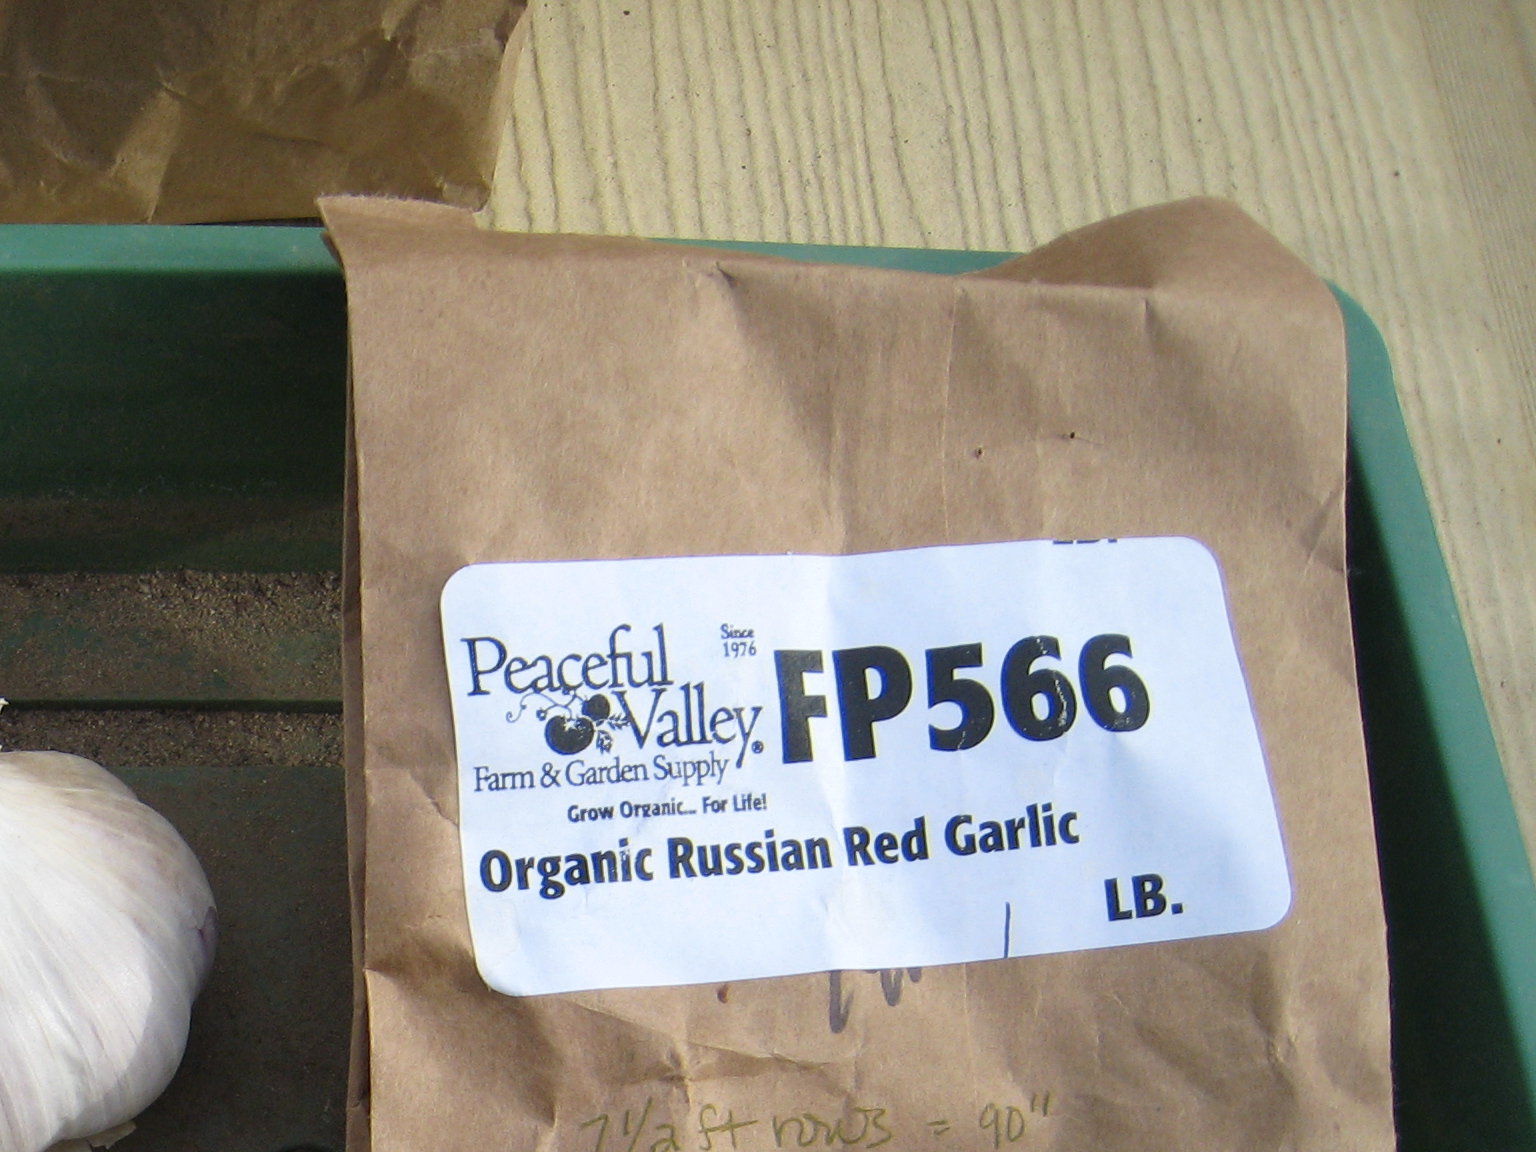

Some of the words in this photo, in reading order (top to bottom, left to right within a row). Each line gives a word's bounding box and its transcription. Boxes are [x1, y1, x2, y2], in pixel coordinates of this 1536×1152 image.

[720, 623, 755, 639] Since
[723, 640, 757, 658] 1976
[460, 622, 675, 696] Peaceful
[773, 633, 1151, 764] FP566
[474, 766, 535, 792] Farm
[540, 762, 561, 788] &
[565, 756, 650, 787] Garden
[653, 751, 729, 787] Supply
[568, 804, 614, 823] Grow
[703, 796, 728, 814] For
[733, 792, 768, 813] Life!
[479, 837, 654, 899] Organic
[667, 829, 833, 879] Russian
[843, 817, 930, 867] Red
[944, 802, 1081, 857] Garlic
[1104, 873, 1184, 922] LB.
